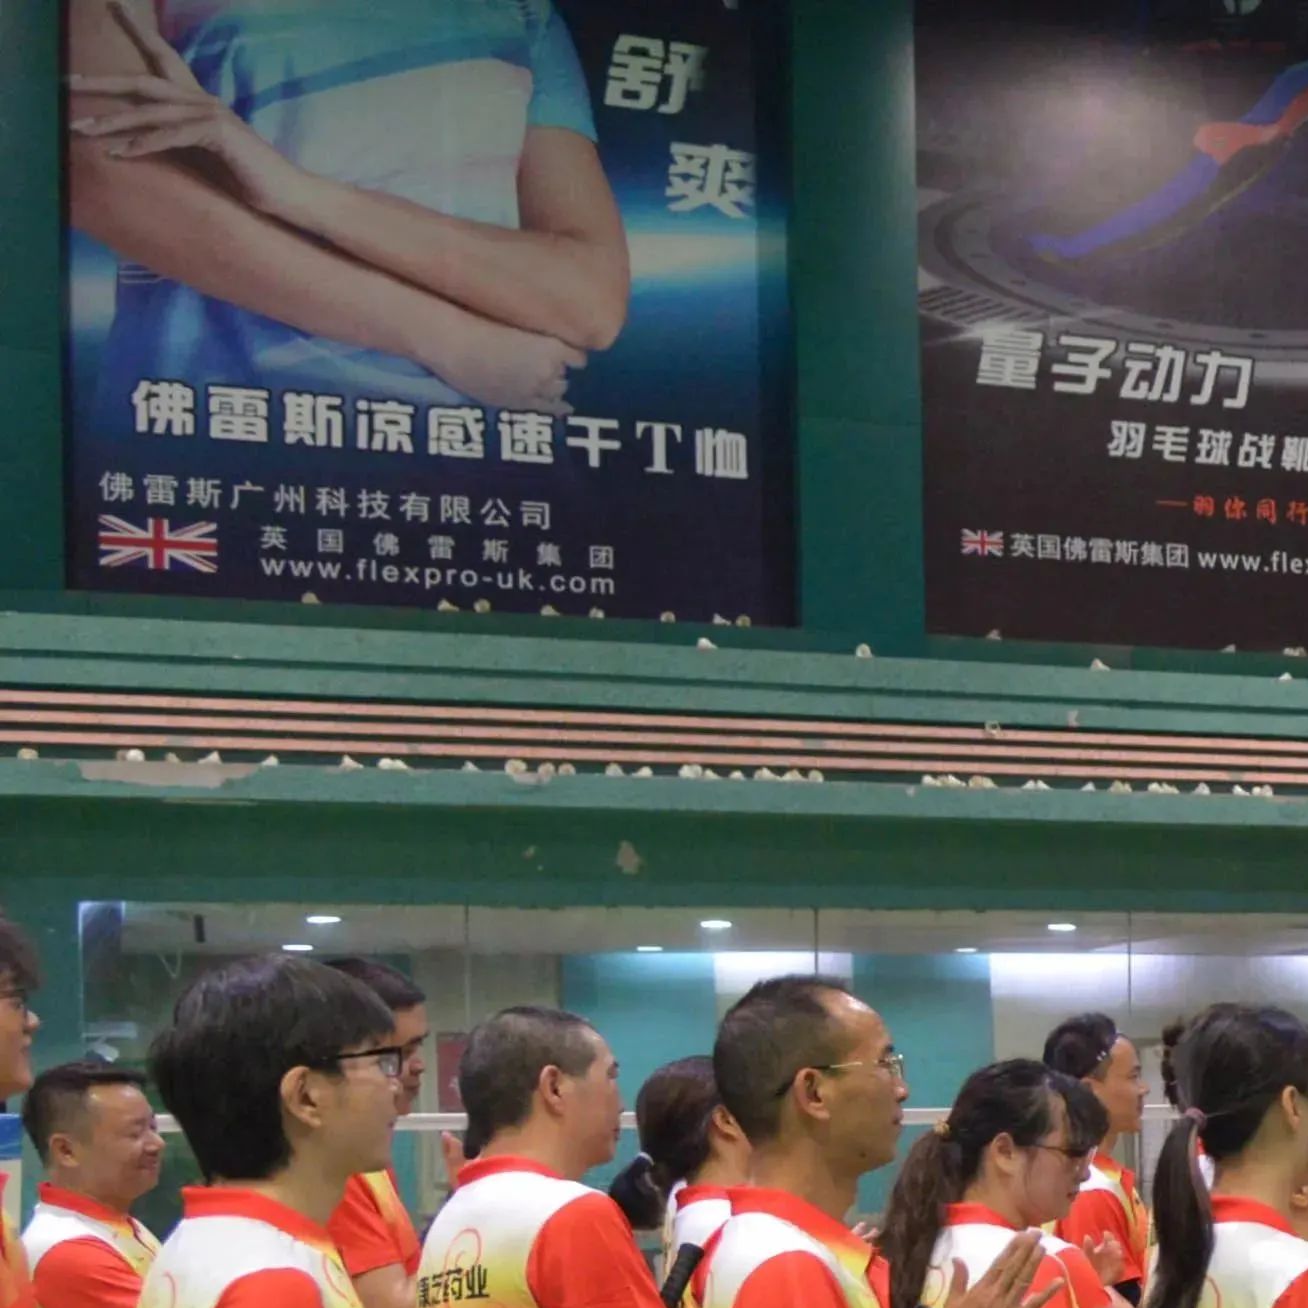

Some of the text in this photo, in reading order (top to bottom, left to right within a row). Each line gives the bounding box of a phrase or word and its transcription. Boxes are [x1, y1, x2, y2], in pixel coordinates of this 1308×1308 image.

[976, 328, 1253, 409] 量子动力
[98, 470, 552, 530] 佛雷斯广州科技有限公司
[259, 524, 615, 570] 英国佛雷斯集团
[1010, 532, 1189, 569] 英国佛雷斯集团
[260, 557, 615, 596] www.flexpro-uk.com
